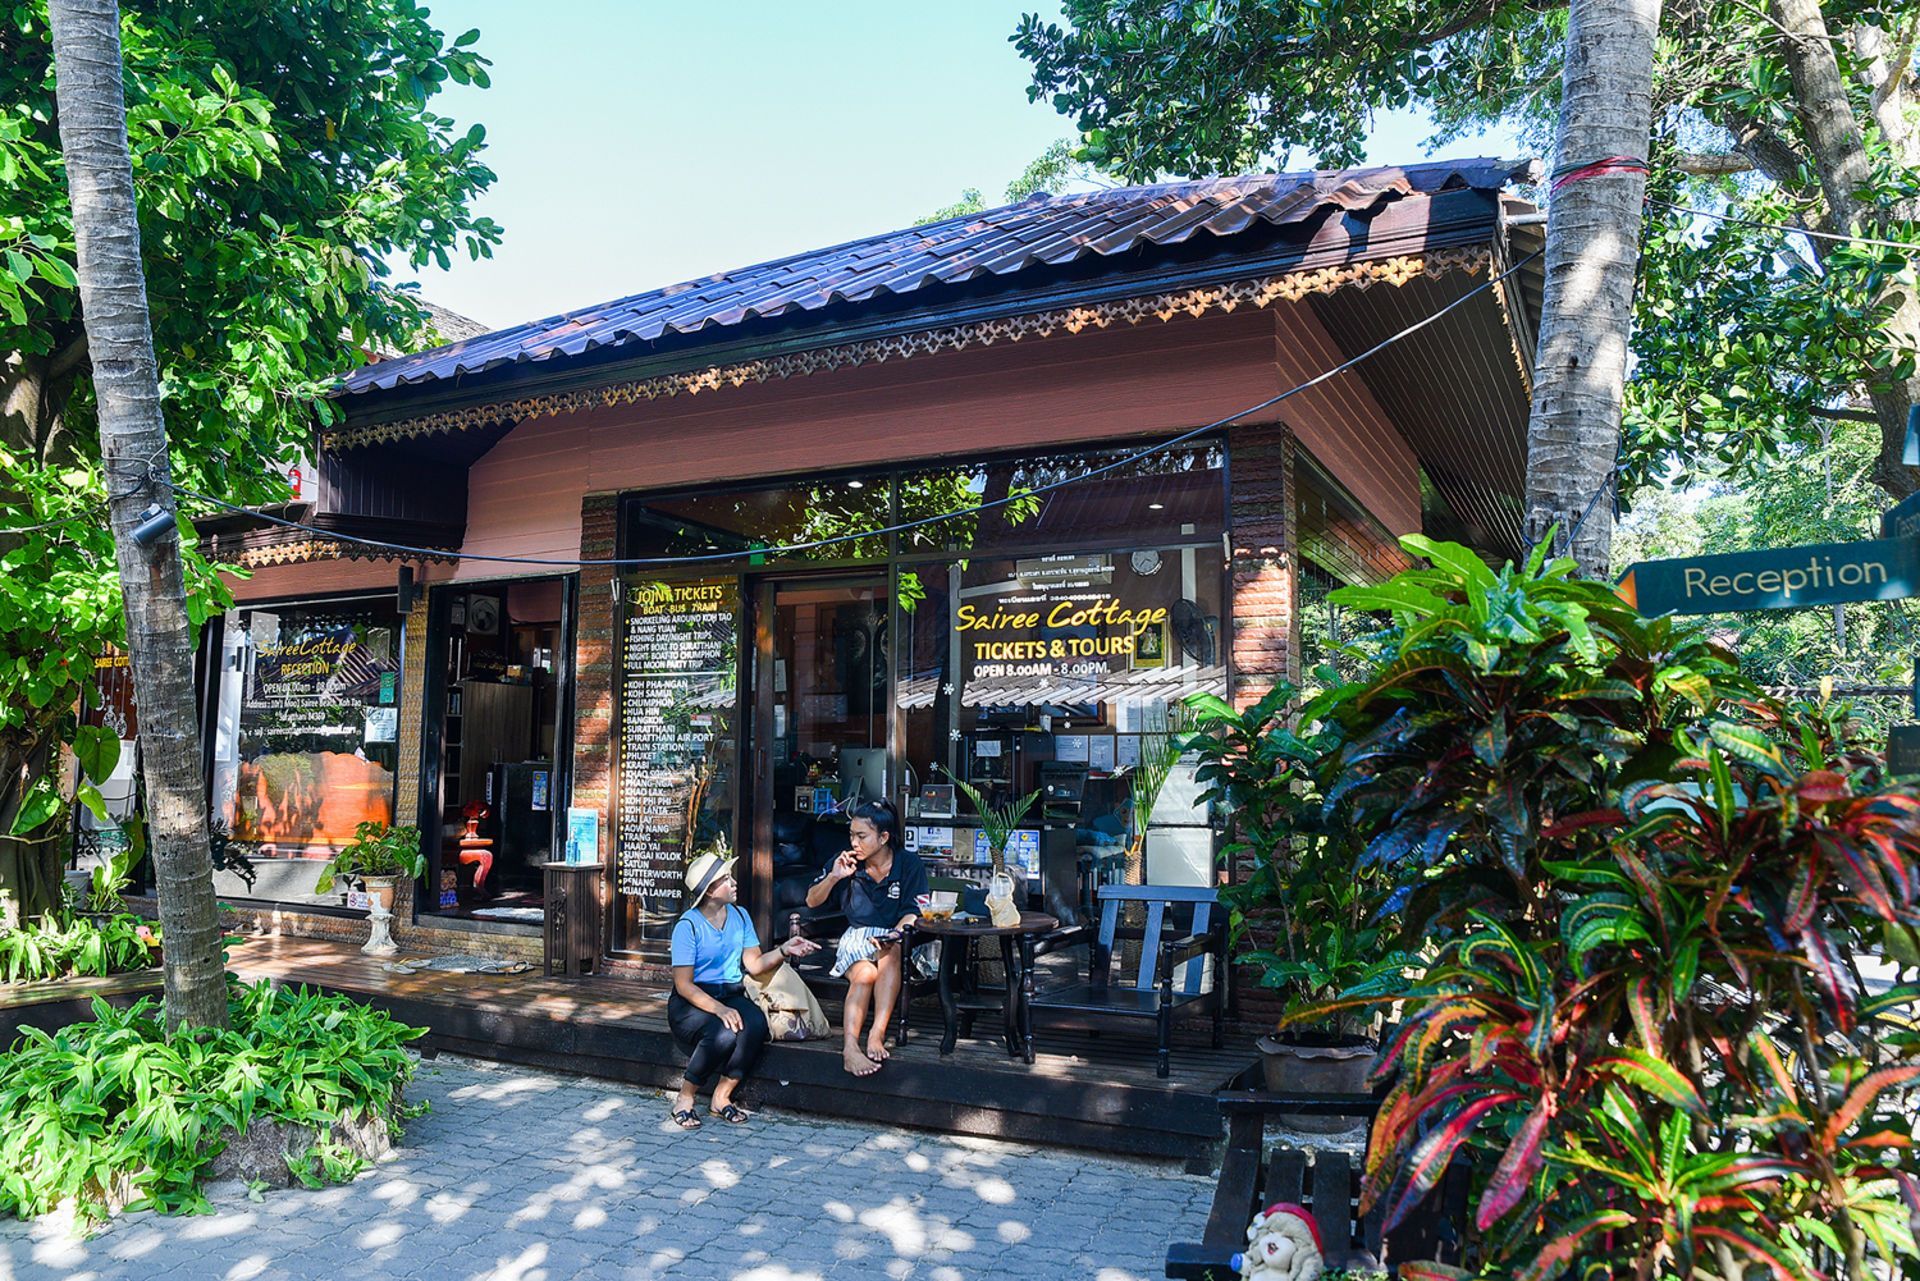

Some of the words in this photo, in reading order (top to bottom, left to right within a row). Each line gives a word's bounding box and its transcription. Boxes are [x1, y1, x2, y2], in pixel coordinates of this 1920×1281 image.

[1684, 556, 1887, 599] Reception
[636, 590, 672, 604] JOINT
[674, 586, 722, 601] TICKETS
[643, 605, 664, 615] BOAT
[670, 604, 686, 613] BUS
[692, 602, 717, 613] TRAIN
[630, 615, 671, 626] SNORKELING
[671, 614, 701, 623] AROUND
[702, 613, 717, 622] KOH
[719, 613, 732, 622] TAO
[955, 605, 1040, 631] Sairee
[1047, 598, 1167, 636] Cottage
[630, 626, 636, 634] &
[637, 626, 657, 634] NANG
[658, 625, 677, 633] YUAN
[630, 634, 655, 643] FISHING
[693, 631, 713, 640] TRIPS
[299, 637, 357, 661] Cottage
[629, 643, 650, 652] NIGHT
[651, 643, 668, 651] BOAT
[670, 642, 679, 651] TO
[679, 641, 722, 651] SURATTHANI
[974, 641, 1046, 660] TICKETS
[1049, 640, 1066, 658] &
[1068, 636, 1135, 656] TOURS
[629, 652, 649, 661] NIGHT
[651, 652, 668, 661] BOAT
[670, 651, 679, 660] TO
[679, 650, 721, 660] CHUMPHON
[281, 662, 330, 675] RECEPTION
[628, 662, 642, 670] FULL
[643, 661, 665, 669] MOON
[666, 661, 688, 669] PARTY
[688, 660, 704, 669] TRIP
[974, 664, 1005, 678] OPEN
[1006, 662, 1052, 676] 8.00AM
[263, 683, 282, 694] OPEN
[627, 680, 645, 689] KOH
[646, 680, 688, 689] PHA-NGAN
[627, 689, 645, 698] KOH
[646, 689, 673, 698] SAMUI
[627, 699, 673, 707] CHUMPHON
[627, 707, 644, 715] HUA
[645, 707, 660, 715] HIN
[627, 716, 664, 724] BANGKOK
[627, 725, 676, 733] SURATTHANI
[627, 734, 676, 742] SURATTHANI
[677, 733, 690, 742] AIR
[692, 733, 714, 742] PORT
[627, 743, 650, 751] TRAIN
[652, 743, 685, 751] STATION
[626, 752, 657, 760] PHUKET
[626, 761, 650, 769] KRABI
[626, 770, 648, 778] KHAO
[625, 779, 673, 788] PHANG-NGA
[625, 788, 647, 796] KHAO
[649, 788, 664, 796] LAK
[625, 797, 641, 805] KOH
[643, 797, 657, 805] PHI
[657, 797, 673, 805] PHI
[625, 806, 641, 814] KOH
[643, 806, 668, 814] LANTA
[624, 815, 639, 823] RAI
[640, 816, 654, 824] LAY
[624, 825, 643, 833] AOW
[645, 825, 669, 833] NANG
[624, 833, 651, 841] TRANG
[624, 842, 647, 850] HAAD
[648, 842, 661, 851] YAI
[623, 851, 654, 860] SUNGAI
[655, 852, 682, 861] KOLOK
[623, 860, 650, 868] SATUN
[623, 869, 683, 879] BUTTERWORTH
[623, 878, 655, 887] PENANG
[622, 887, 648, 895] KUALA
[649, 888, 682, 898] LAMPER
